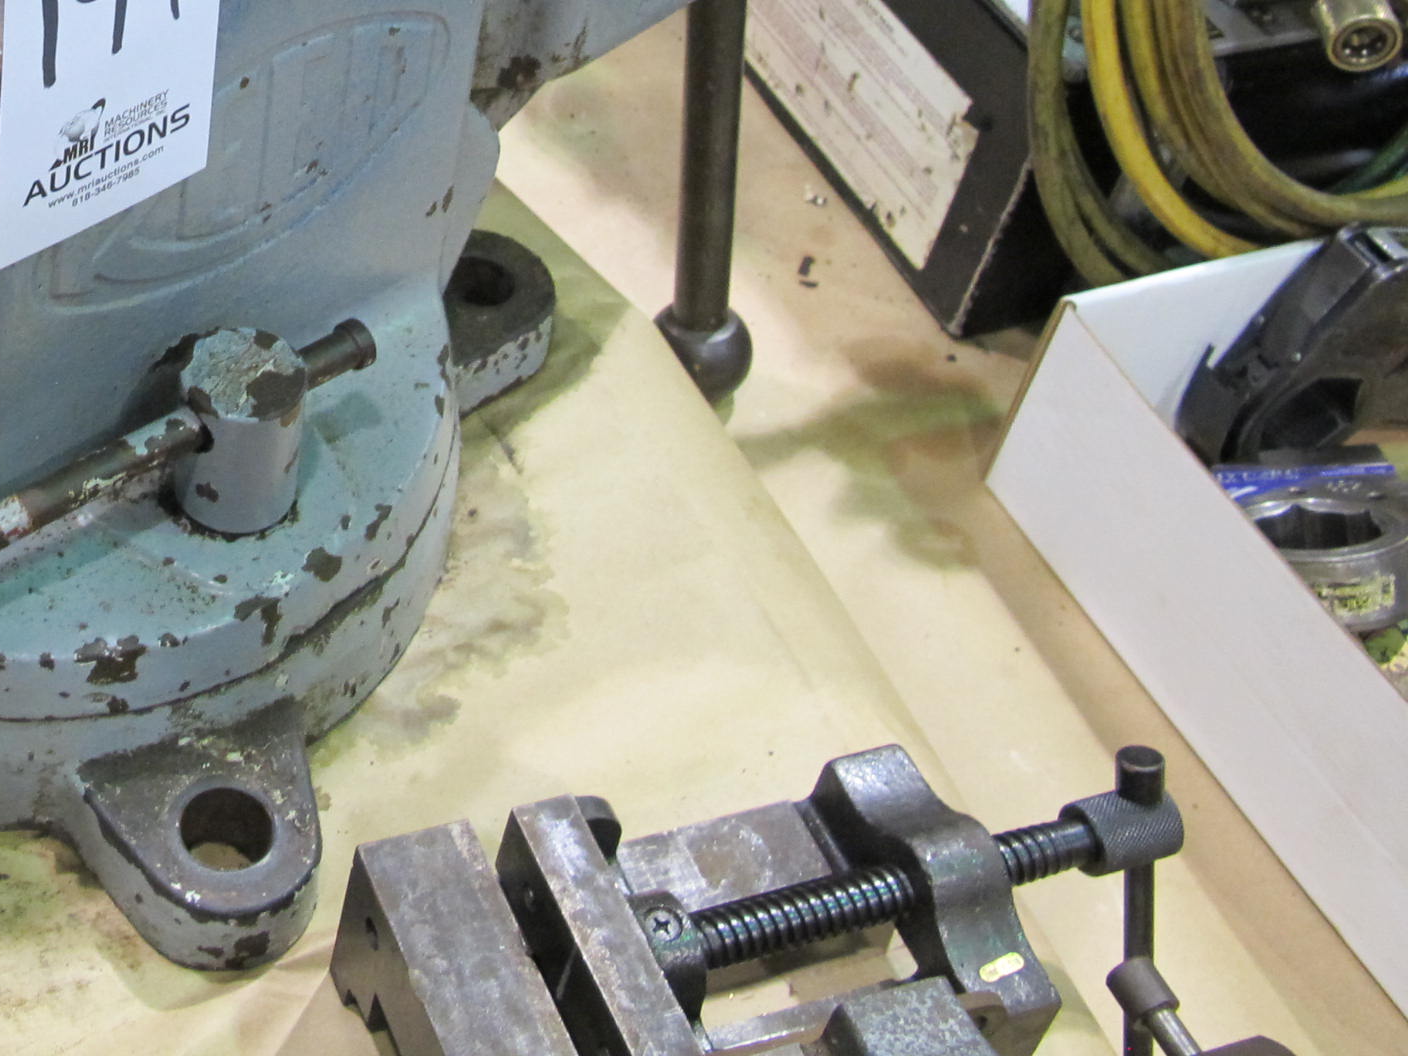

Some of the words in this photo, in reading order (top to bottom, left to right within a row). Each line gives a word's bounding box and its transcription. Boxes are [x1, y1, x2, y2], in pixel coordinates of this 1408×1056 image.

[103, 100, 169, 138] RESOURCES
[104, 88, 170, 129] MACHINERY
[22, 103, 190, 207] AUCTIONS
[63, 131, 97, 164] MRI
[48, 145, 165, 208] www.mriauctions.com
